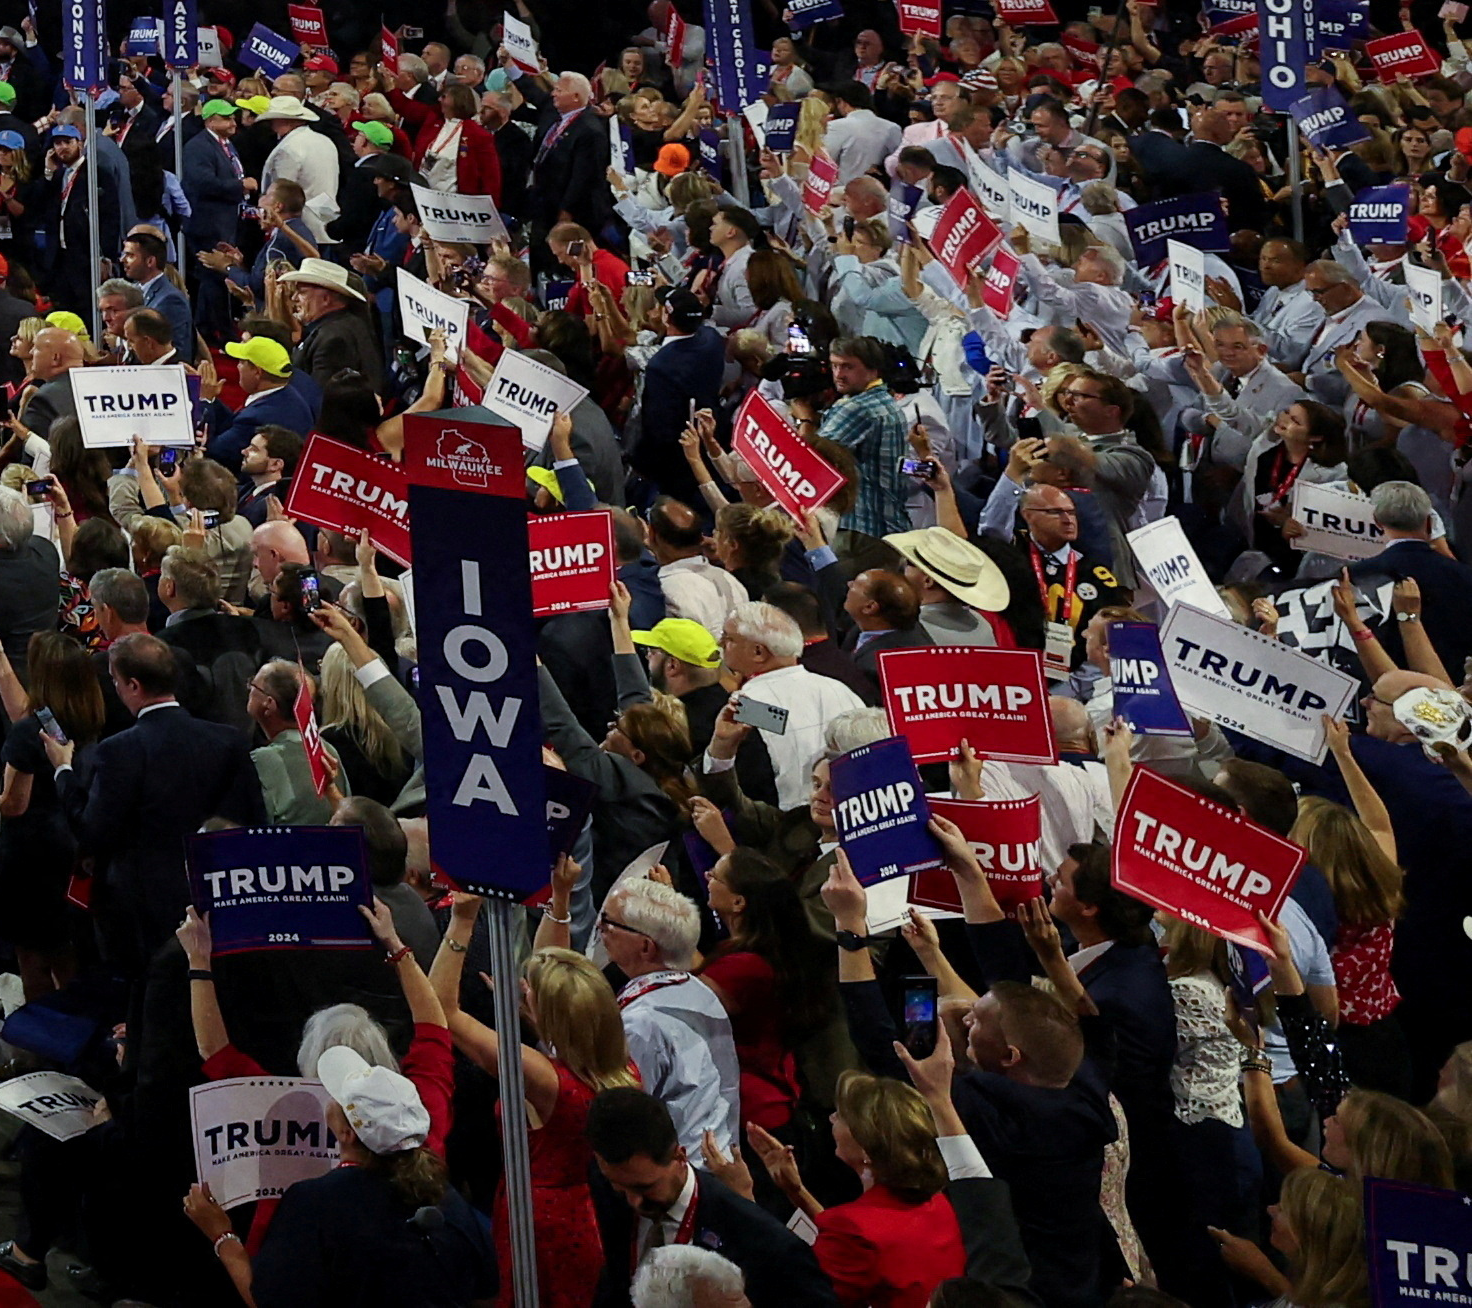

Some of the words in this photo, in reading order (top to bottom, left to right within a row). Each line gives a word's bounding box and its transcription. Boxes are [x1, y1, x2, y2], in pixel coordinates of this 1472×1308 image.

[290, 19, 321, 32] TRUMP
[902, 6, 938, 19] TRUMP
[130, 29, 159, 39] TRUMP
[504, 26, 532, 50] TRUMP
[248, 38, 291, 65] TRUMP
[1373, 45, 1423, 64] TRUMP
[730, 29, 747, 109] CAROLINA
[1299, 107, 1345, 134] TRUMP
[421, 206, 493, 223] TRUMP
[1009, 196, 1051, 218] TRUMP
[1350, 204, 1402, 219] TRUMP
[941, 207, 981, 263] TRUMP
[1135, 212, 1215, 237] TRUMP
[1174, 263, 1202, 285] TRUMP
[405, 296, 458, 334] TRUMP
[85, 393, 178, 411] TRUMP
[497, 377, 558, 416] TRUMP
[426, 457, 502, 475] MILWAUKEE
[743, 413, 816, 499] TRUMP
[1150, 552, 1189, 586] TRUMP
[435, 560, 522, 816] IOWA
[1173, 638, 1327, 713] TRUMP
[894, 683, 1032, 713] TRUMP
[839, 782, 915, 824] TRUMP
[1134, 810, 1272, 898] TRUMP
[204, 865, 355, 897] TRUMP
[1134, 844, 1156, 861] MAKE
[1159, 857, 1194, 881] AMERICA
[1196, 878, 1222, 894] GREAT
[1225, 892, 1253, 911] AGAIN!
[268, 933, 300, 943] 2024
